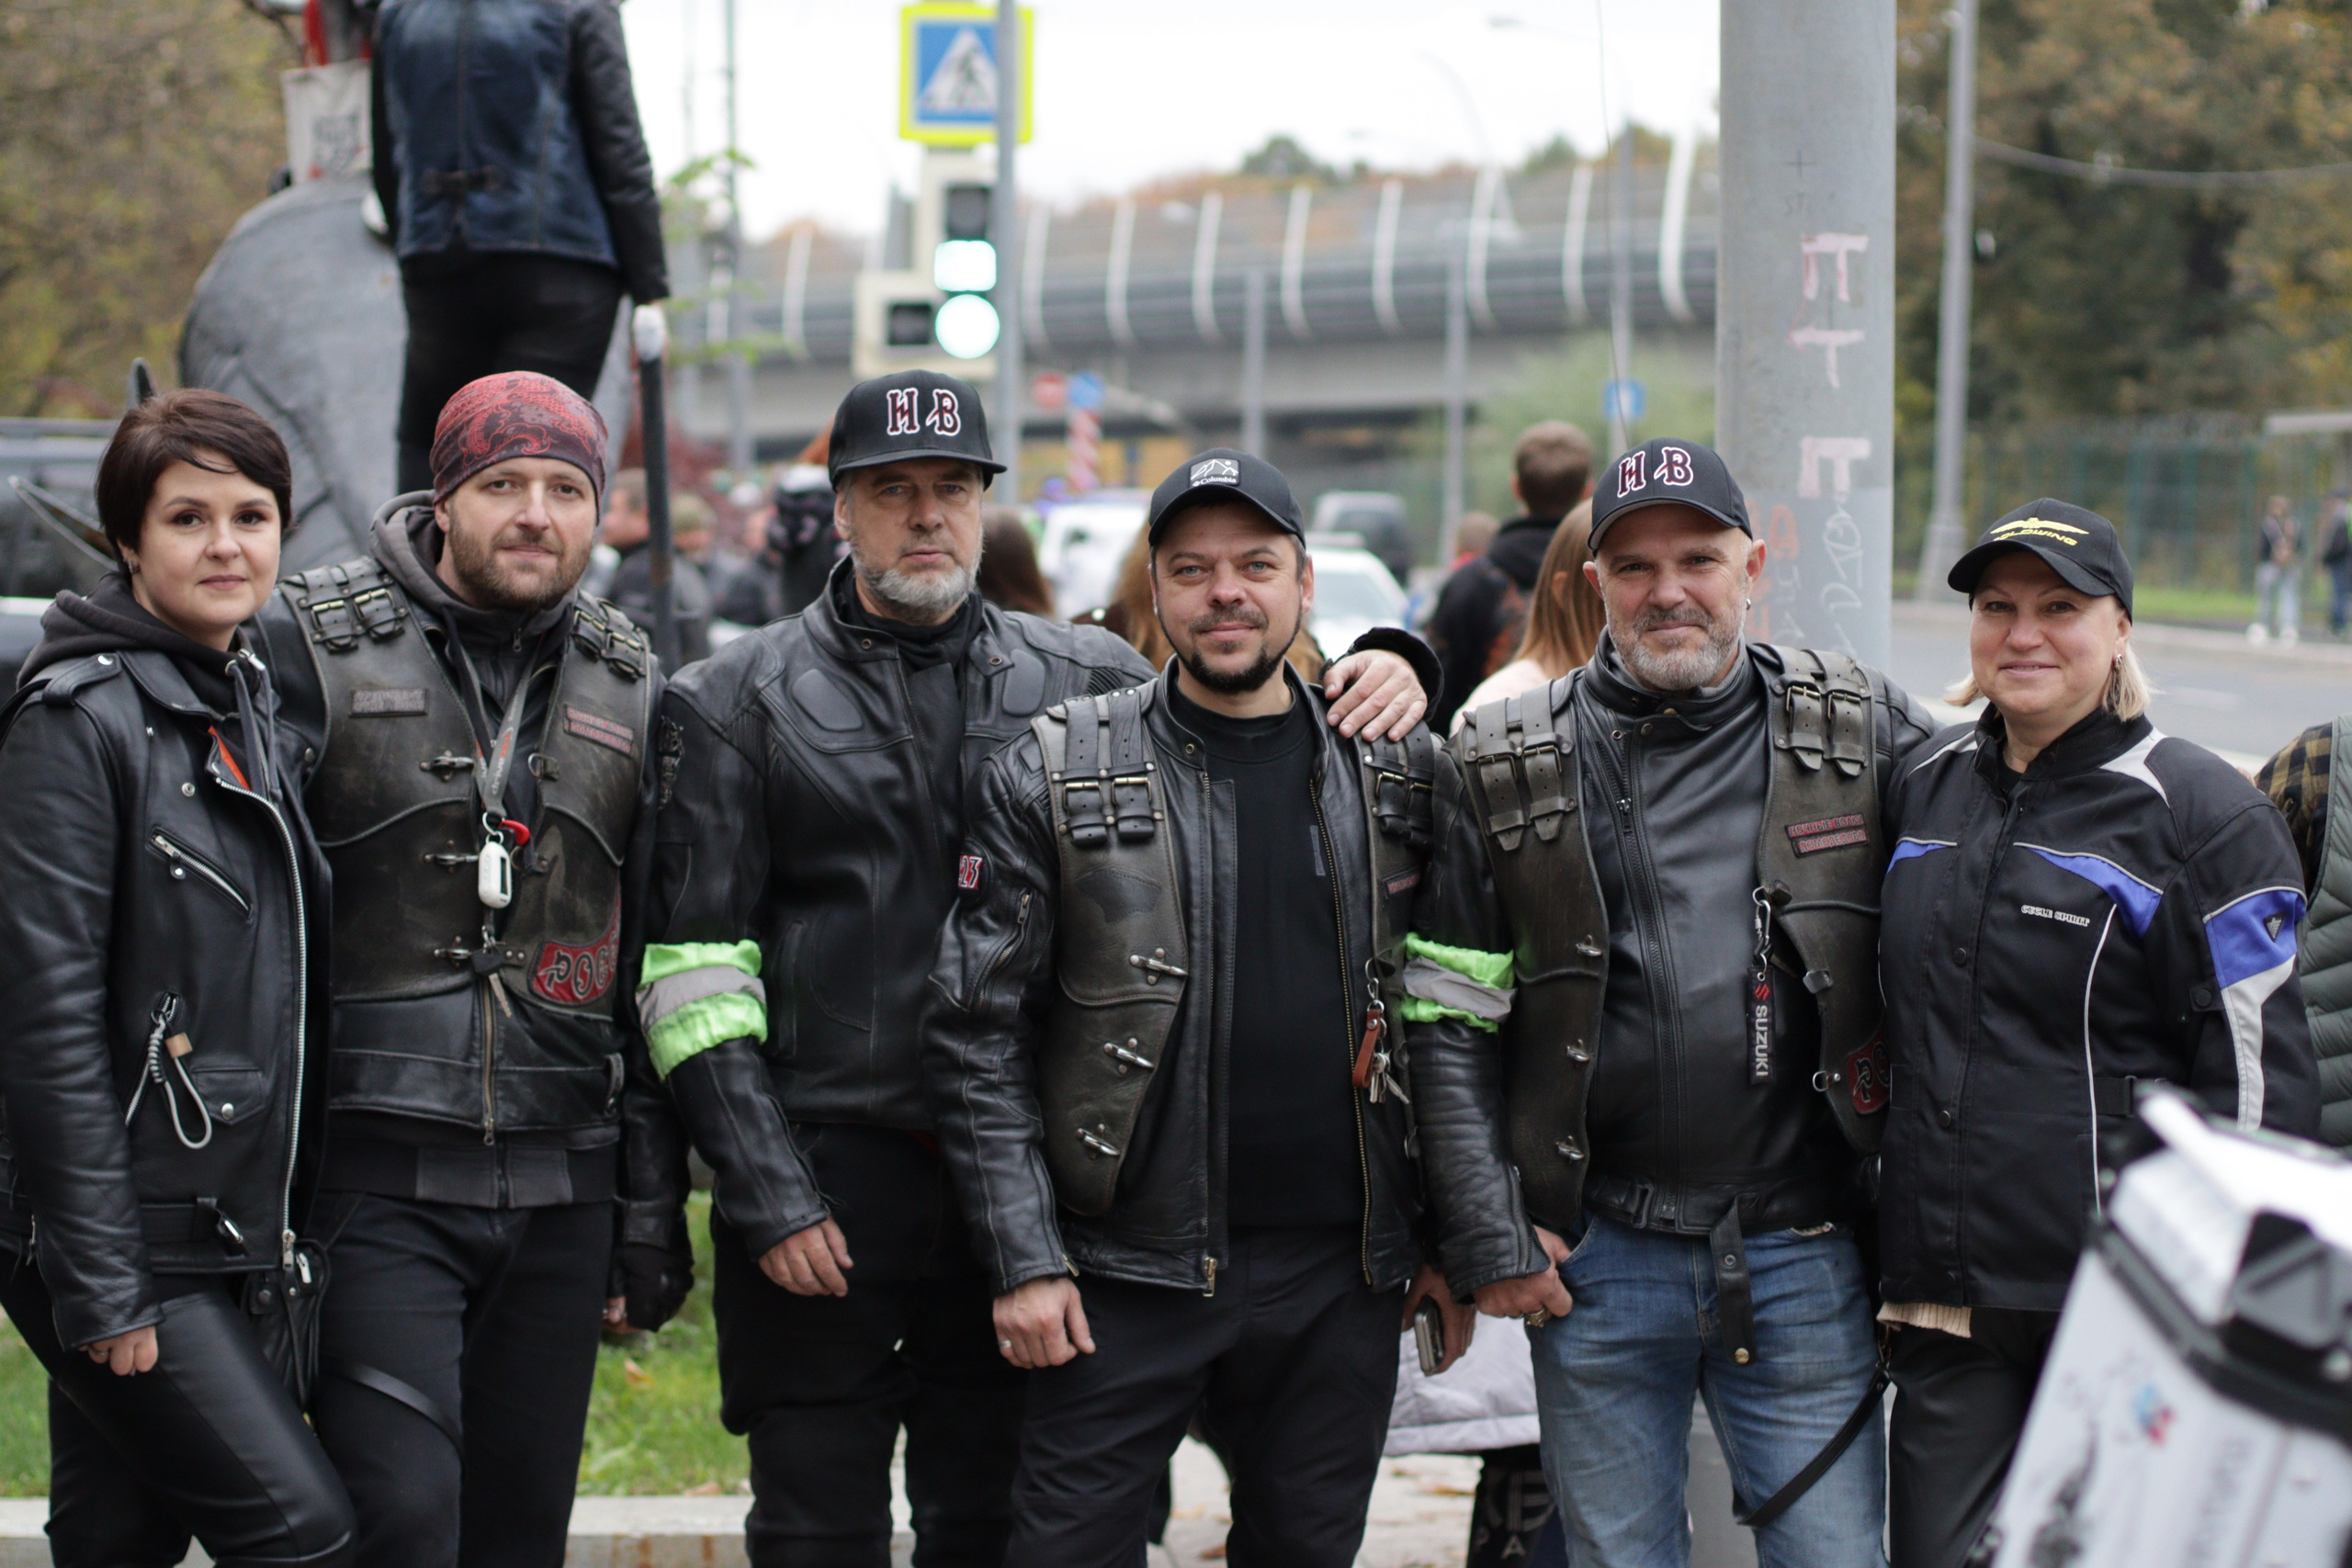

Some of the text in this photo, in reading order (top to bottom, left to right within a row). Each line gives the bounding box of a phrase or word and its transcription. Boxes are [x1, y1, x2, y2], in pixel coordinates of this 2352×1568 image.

[1200, 476, 1238, 485] Columbia
[2021, 904, 2090, 928] CYCLE SPIRIT
[1755, 1004, 1769, 1077] SUZUKI
